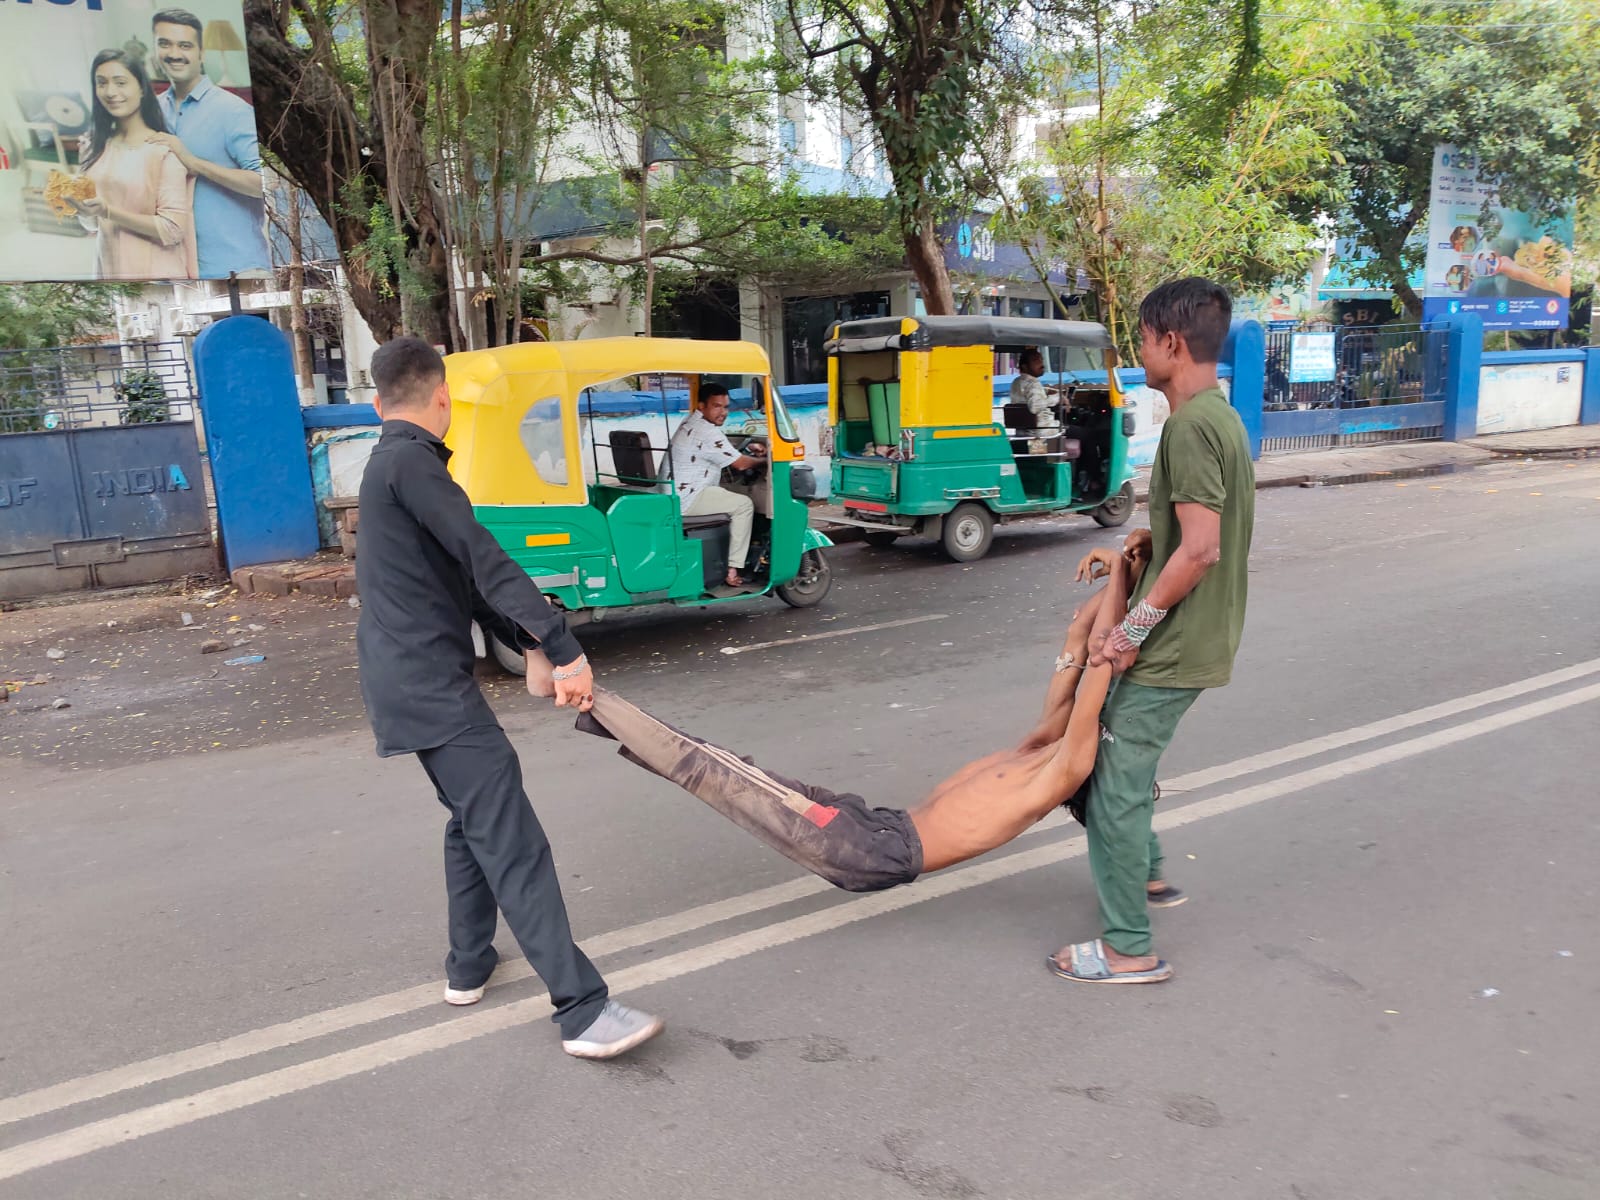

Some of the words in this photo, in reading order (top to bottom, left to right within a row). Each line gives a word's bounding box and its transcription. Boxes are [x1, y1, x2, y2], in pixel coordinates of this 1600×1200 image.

[973, 225, 995, 262] SBI
[1343, 309, 1378, 326] SBI
[92, 464, 191, 497] INDIA
